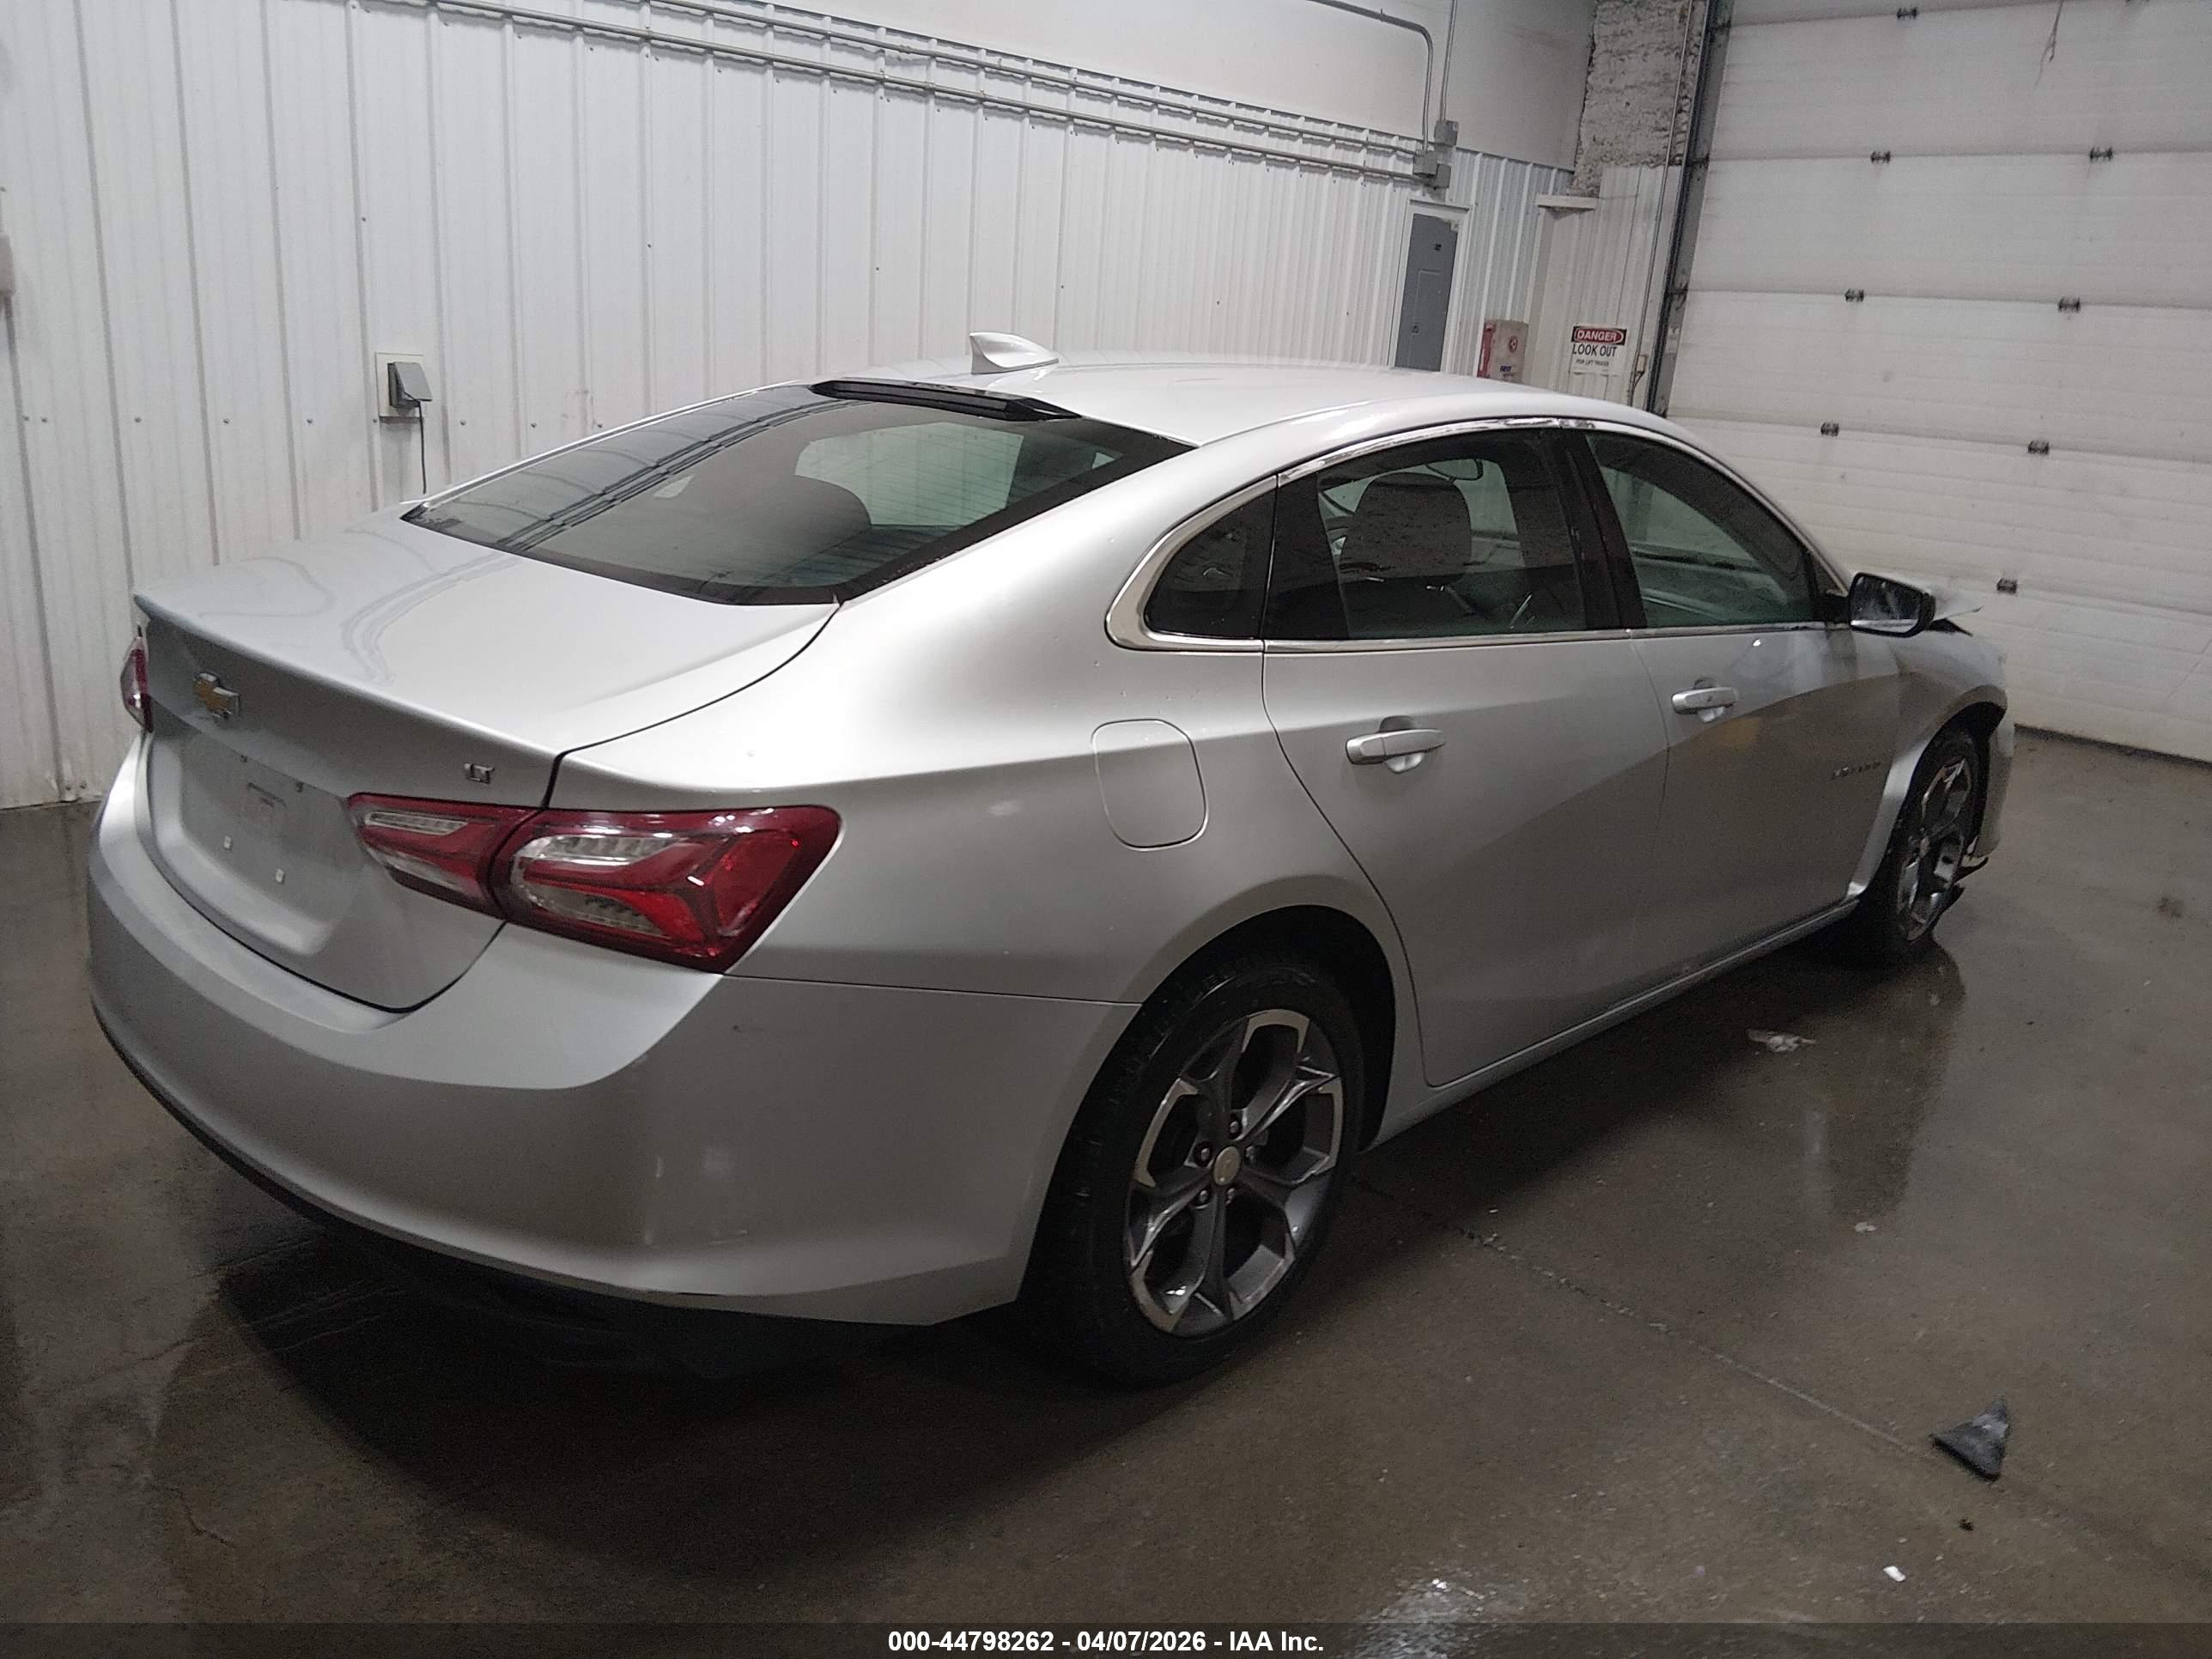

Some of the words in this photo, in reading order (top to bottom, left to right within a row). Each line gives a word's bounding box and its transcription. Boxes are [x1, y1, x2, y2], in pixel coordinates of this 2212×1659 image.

[1577, 330, 1617, 342] DANGER
[1572, 343, 1598, 356] LOOK
[1600, 345, 1617, 357] OUT
